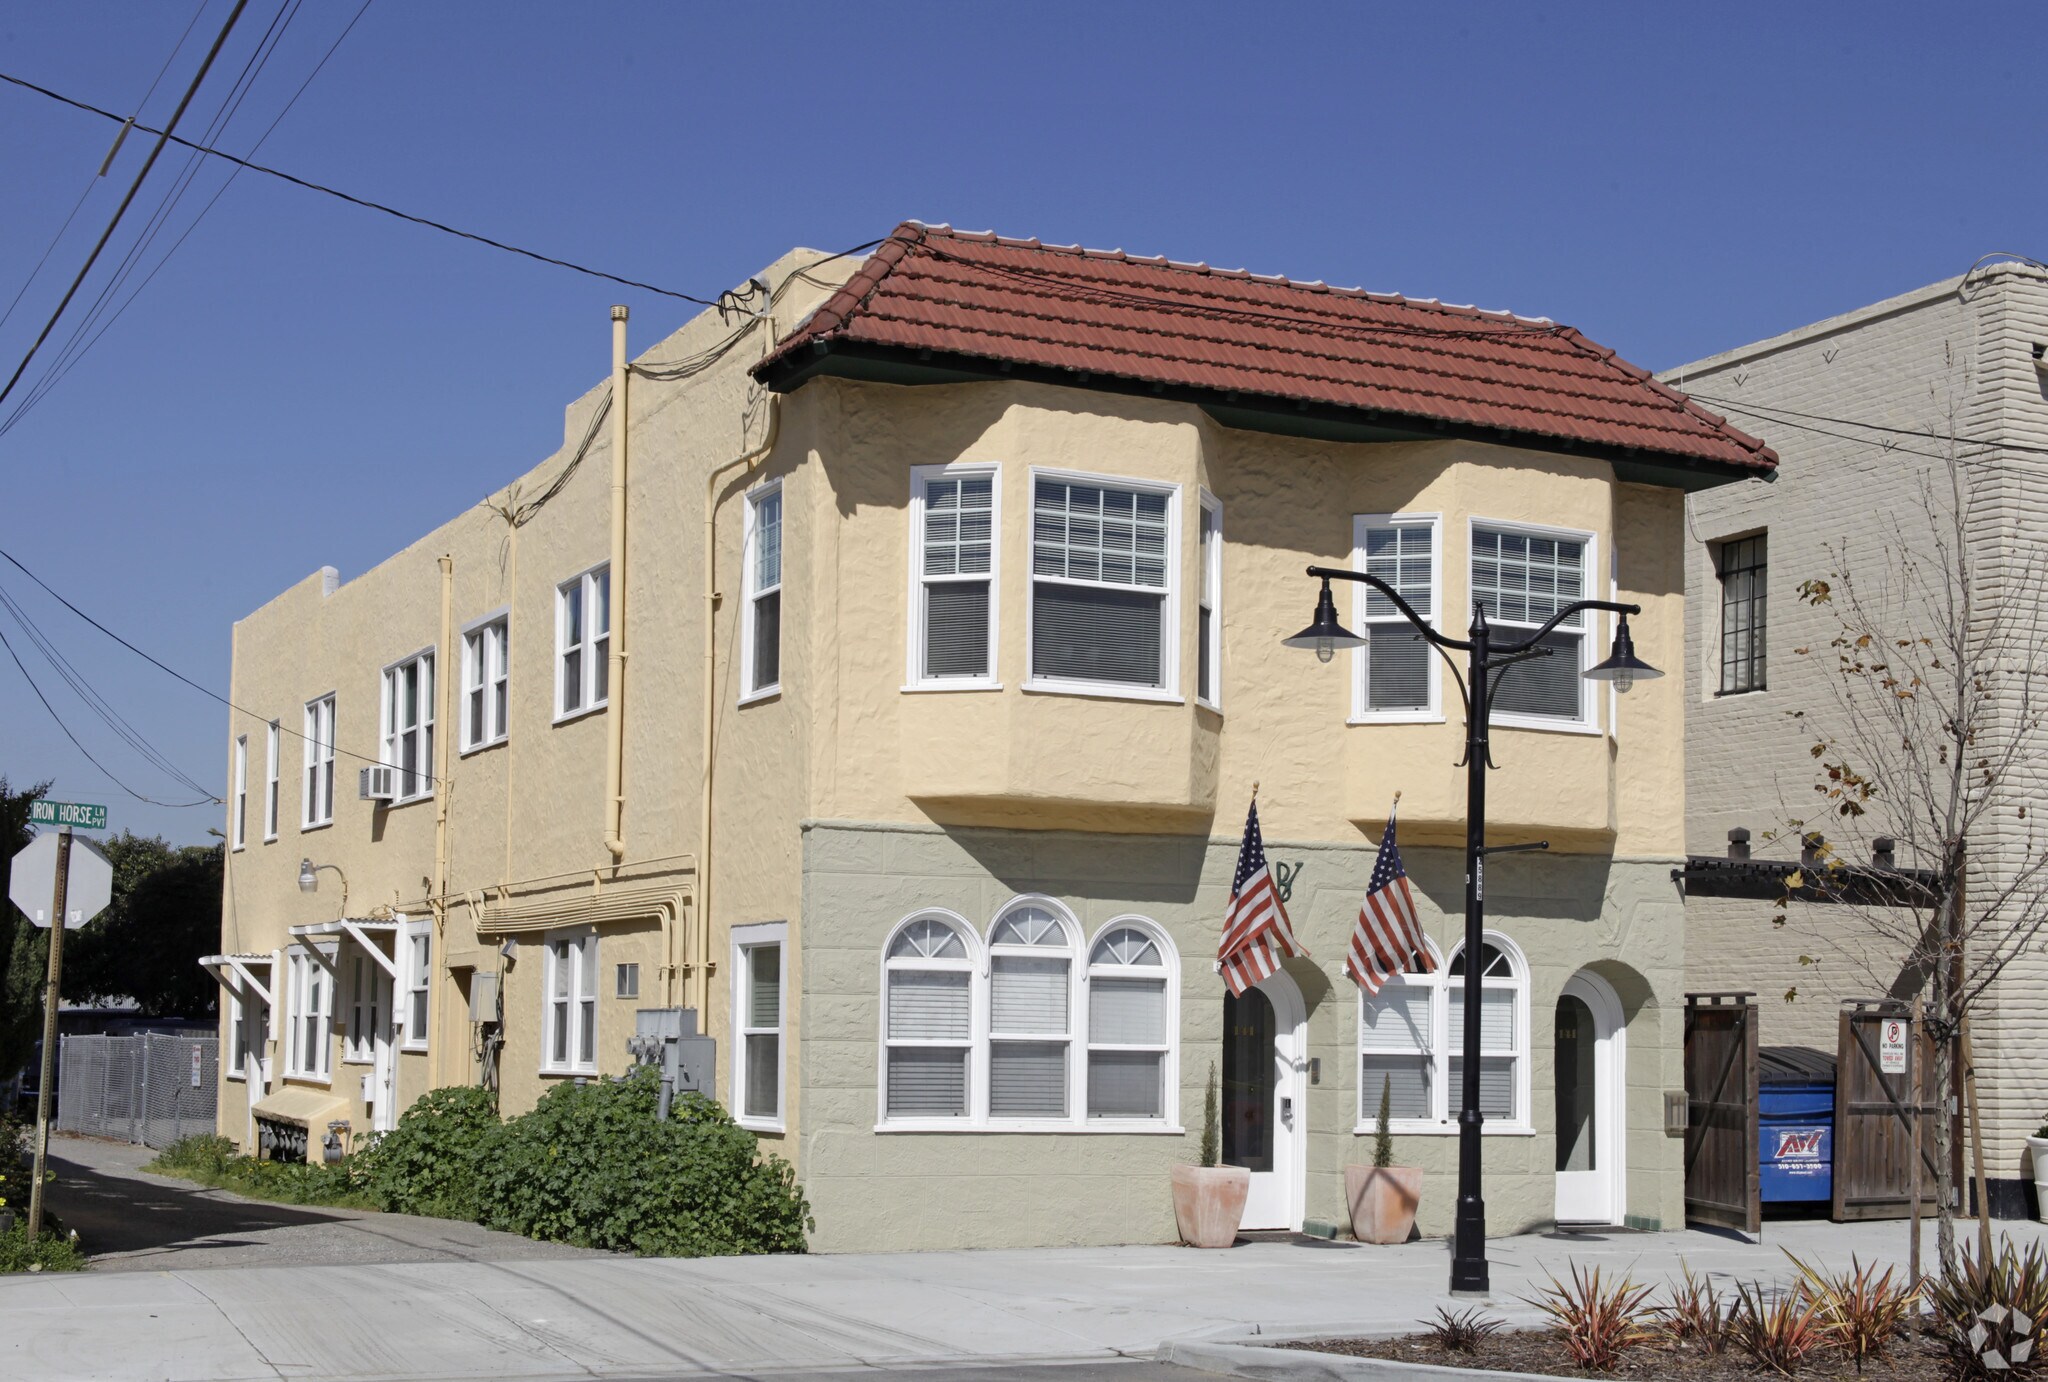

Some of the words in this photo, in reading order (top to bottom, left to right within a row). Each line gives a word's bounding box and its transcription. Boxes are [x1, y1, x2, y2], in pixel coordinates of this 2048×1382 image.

[33, 802, 54, 820] IRON
[60, 805, 92, 824] HORSE
[95, 807, 104, 816] LN
[92, 817, 105, 827] PVT
